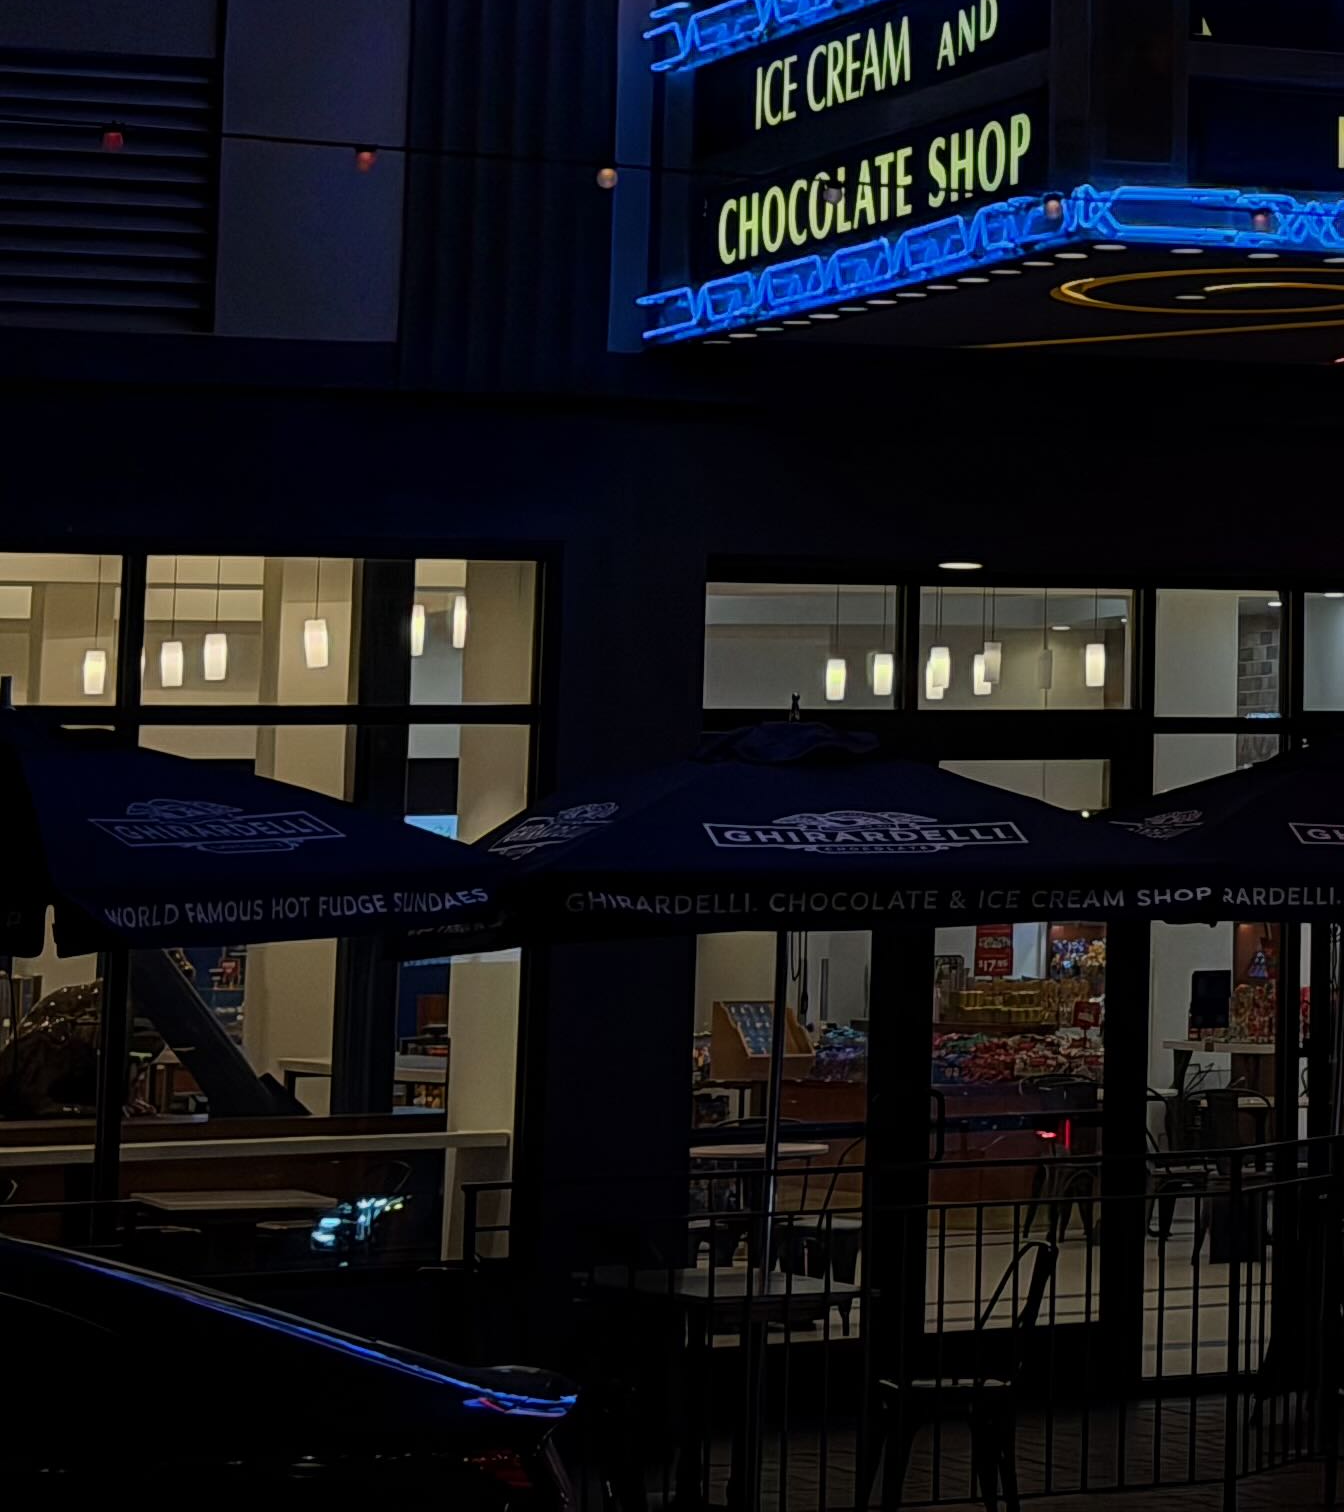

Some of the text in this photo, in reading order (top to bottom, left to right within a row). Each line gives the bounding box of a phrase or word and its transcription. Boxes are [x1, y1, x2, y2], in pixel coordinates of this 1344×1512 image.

[755, 55, 797, 130] ICE
[806, 15, 911, 112] CREAM
[717, 113, 1032, 265] CHOCOLATE SHOP
[104, 887, 489, 929] WORLD FAMOUS HOT FUDGE SUNDAES
[768, 888, 938, 914] CHOCOLATE
[949, 888, 967, 911] &
[977, 888, 1019, 911] ICE
[1031, 887, 1126, 910] CREAM
[1136, 885, 1213, 908] SHOP
